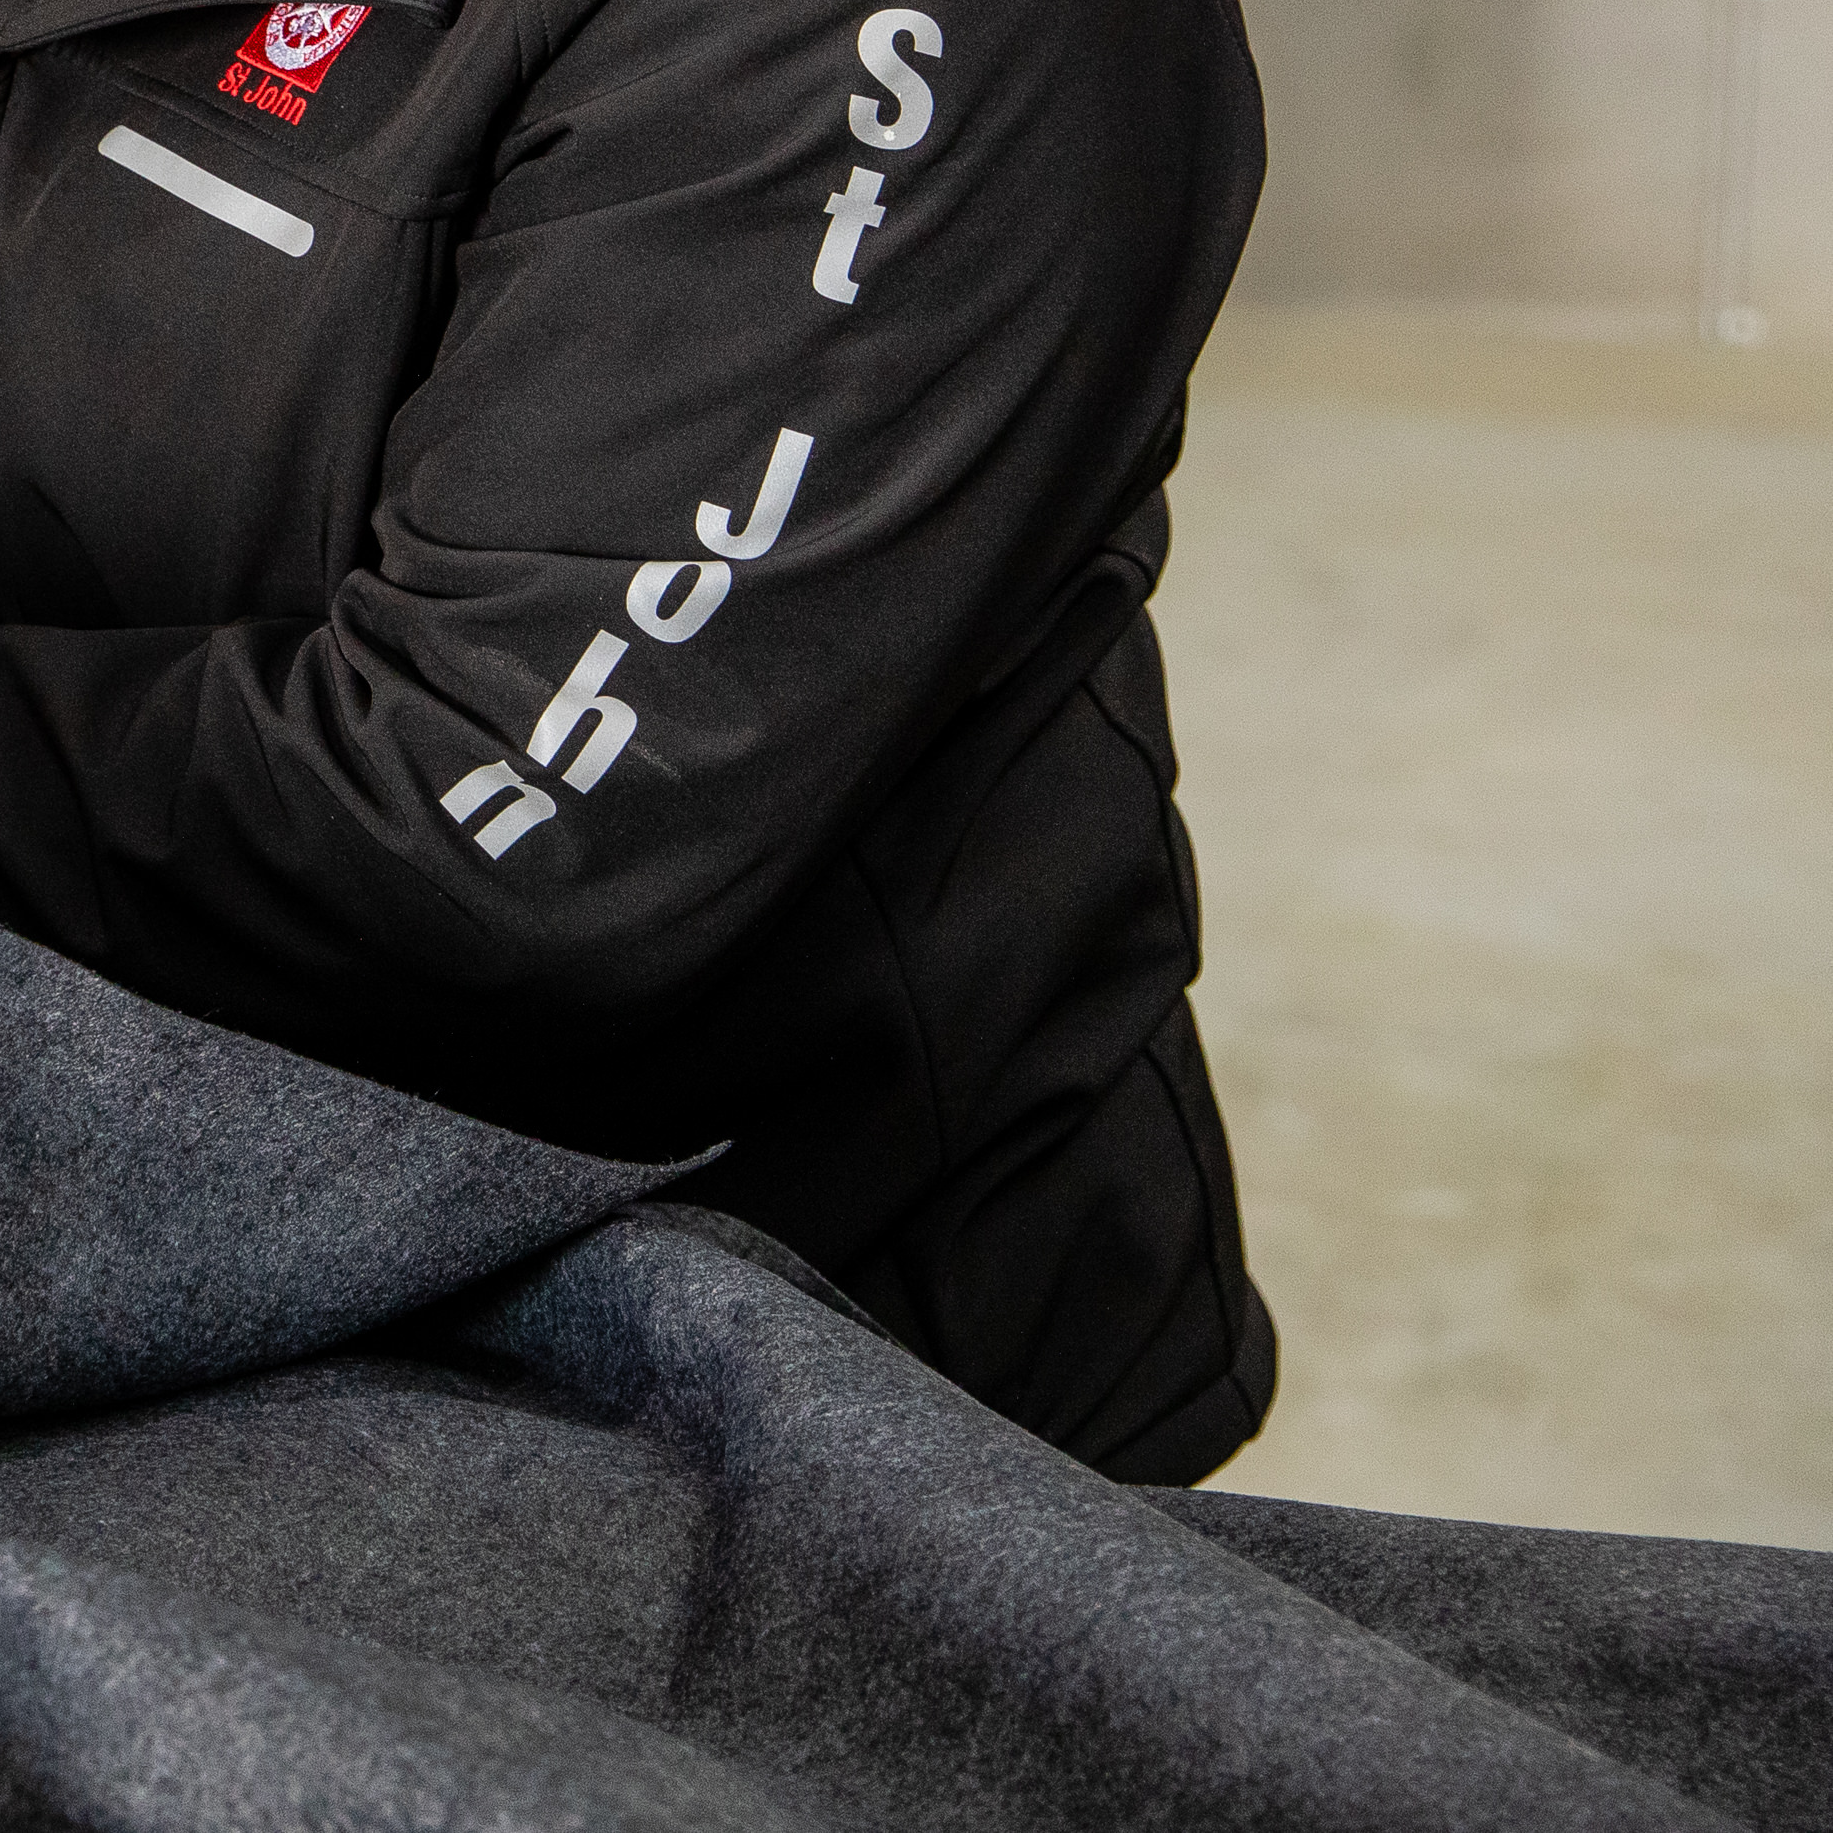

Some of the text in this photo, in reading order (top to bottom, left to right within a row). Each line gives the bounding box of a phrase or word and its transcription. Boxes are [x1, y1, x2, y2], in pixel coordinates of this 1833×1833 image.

[217, 61, 307, 126] St John
[439, 7, 944, 861] St John
